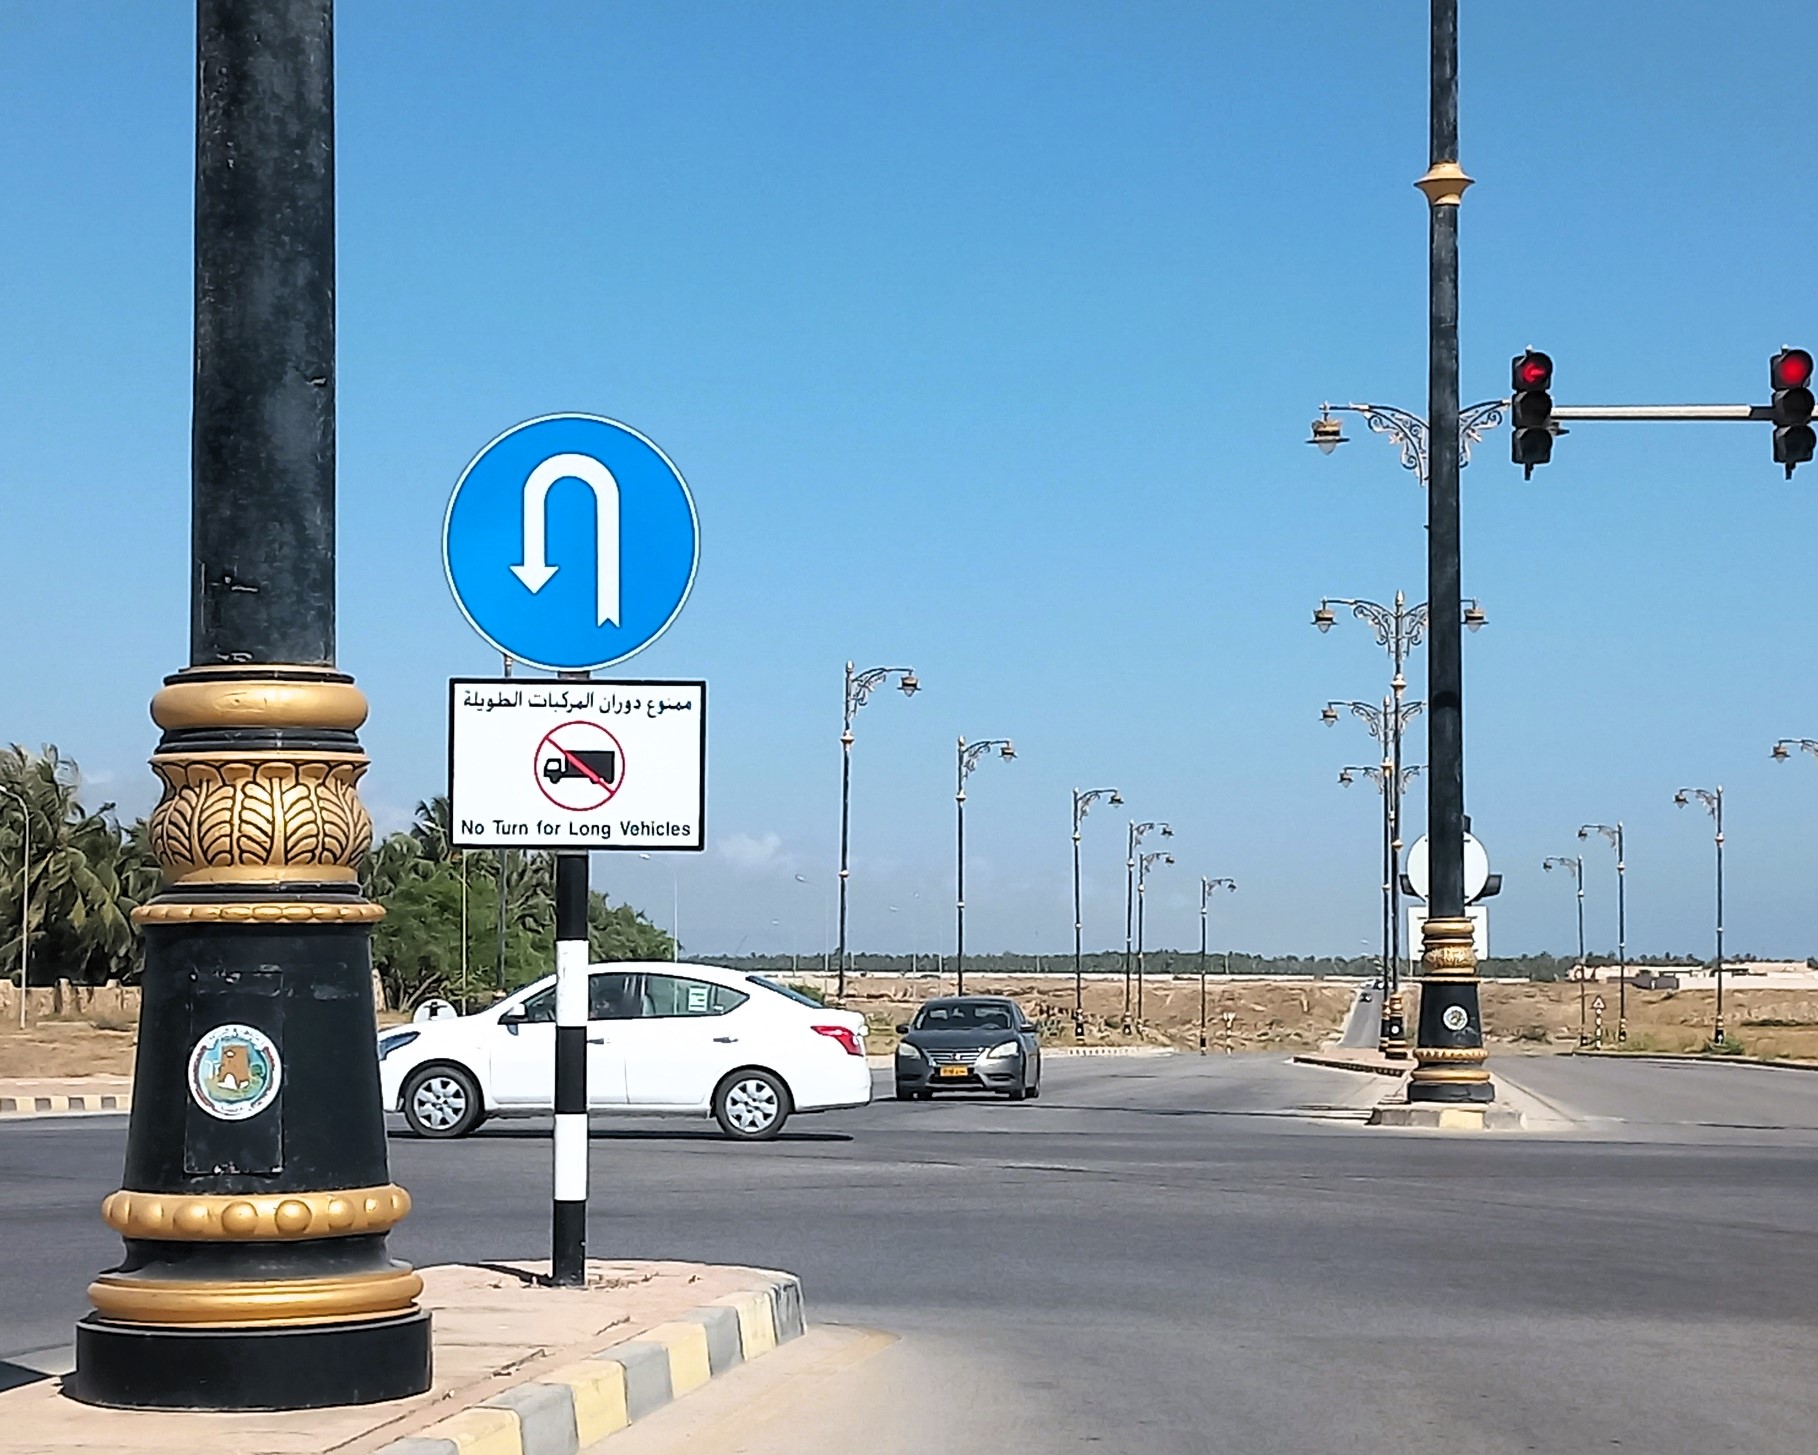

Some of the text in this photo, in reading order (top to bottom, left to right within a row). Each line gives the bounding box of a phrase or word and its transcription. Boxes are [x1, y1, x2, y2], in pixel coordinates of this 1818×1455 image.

[463, 690, 692, 718] ممنوع دوران المركبات الطويلة
[462, 820, 691, 839] No Turn for Long Vehicles
